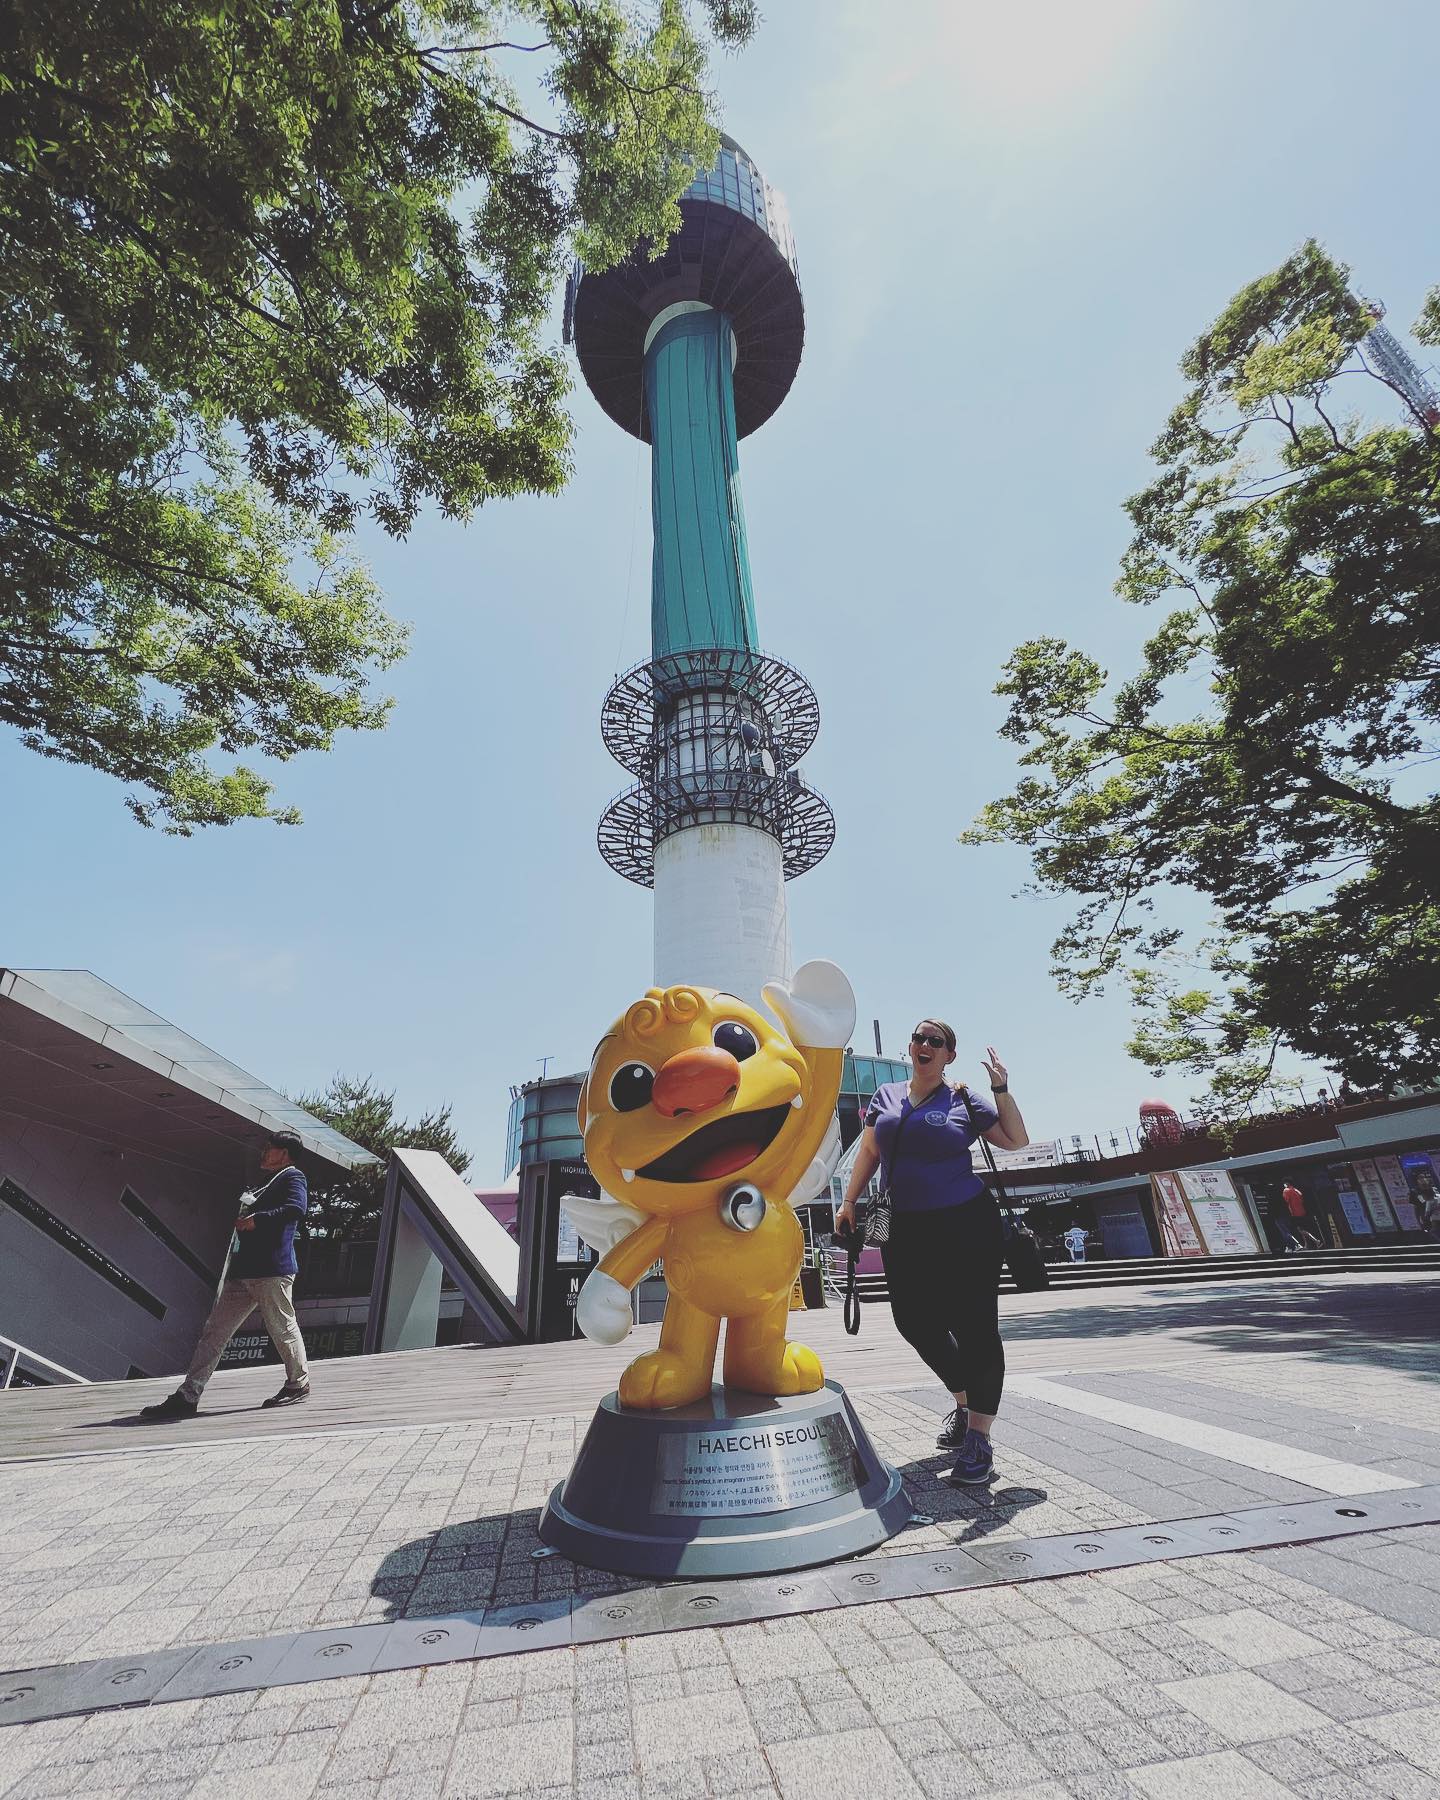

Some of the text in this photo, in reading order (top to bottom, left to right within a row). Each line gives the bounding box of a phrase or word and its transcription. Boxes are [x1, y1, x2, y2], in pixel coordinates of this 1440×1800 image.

[226, 1335, 269, 1348] NSIDE
[221, 1348, 265, 1361] SEOUL
[698, 1424, 828, 1454] HAECHI SEOUL
